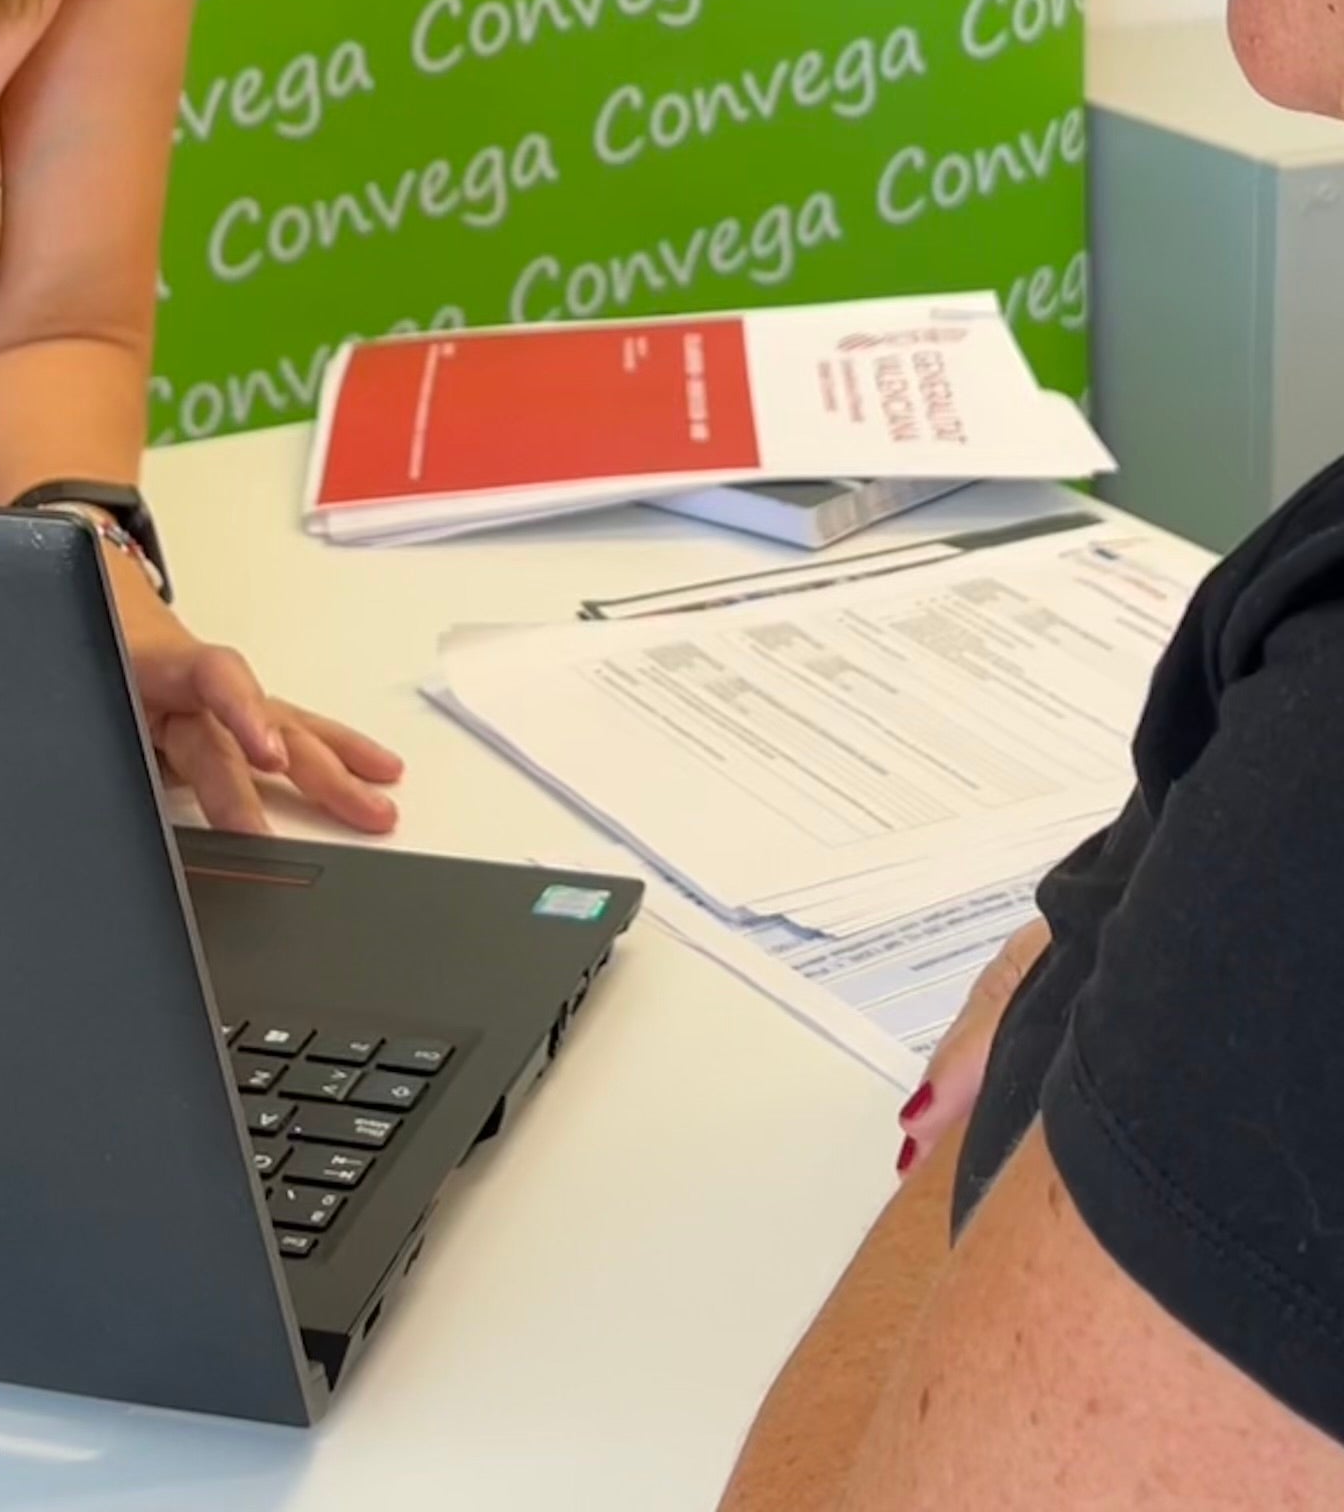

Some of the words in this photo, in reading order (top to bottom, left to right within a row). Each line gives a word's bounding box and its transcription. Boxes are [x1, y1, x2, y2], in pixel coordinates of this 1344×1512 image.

[207, 132, 560, 284] Convega
[591, 24, 927, 168] Convega
[509, 190, 844, 326] Convega
